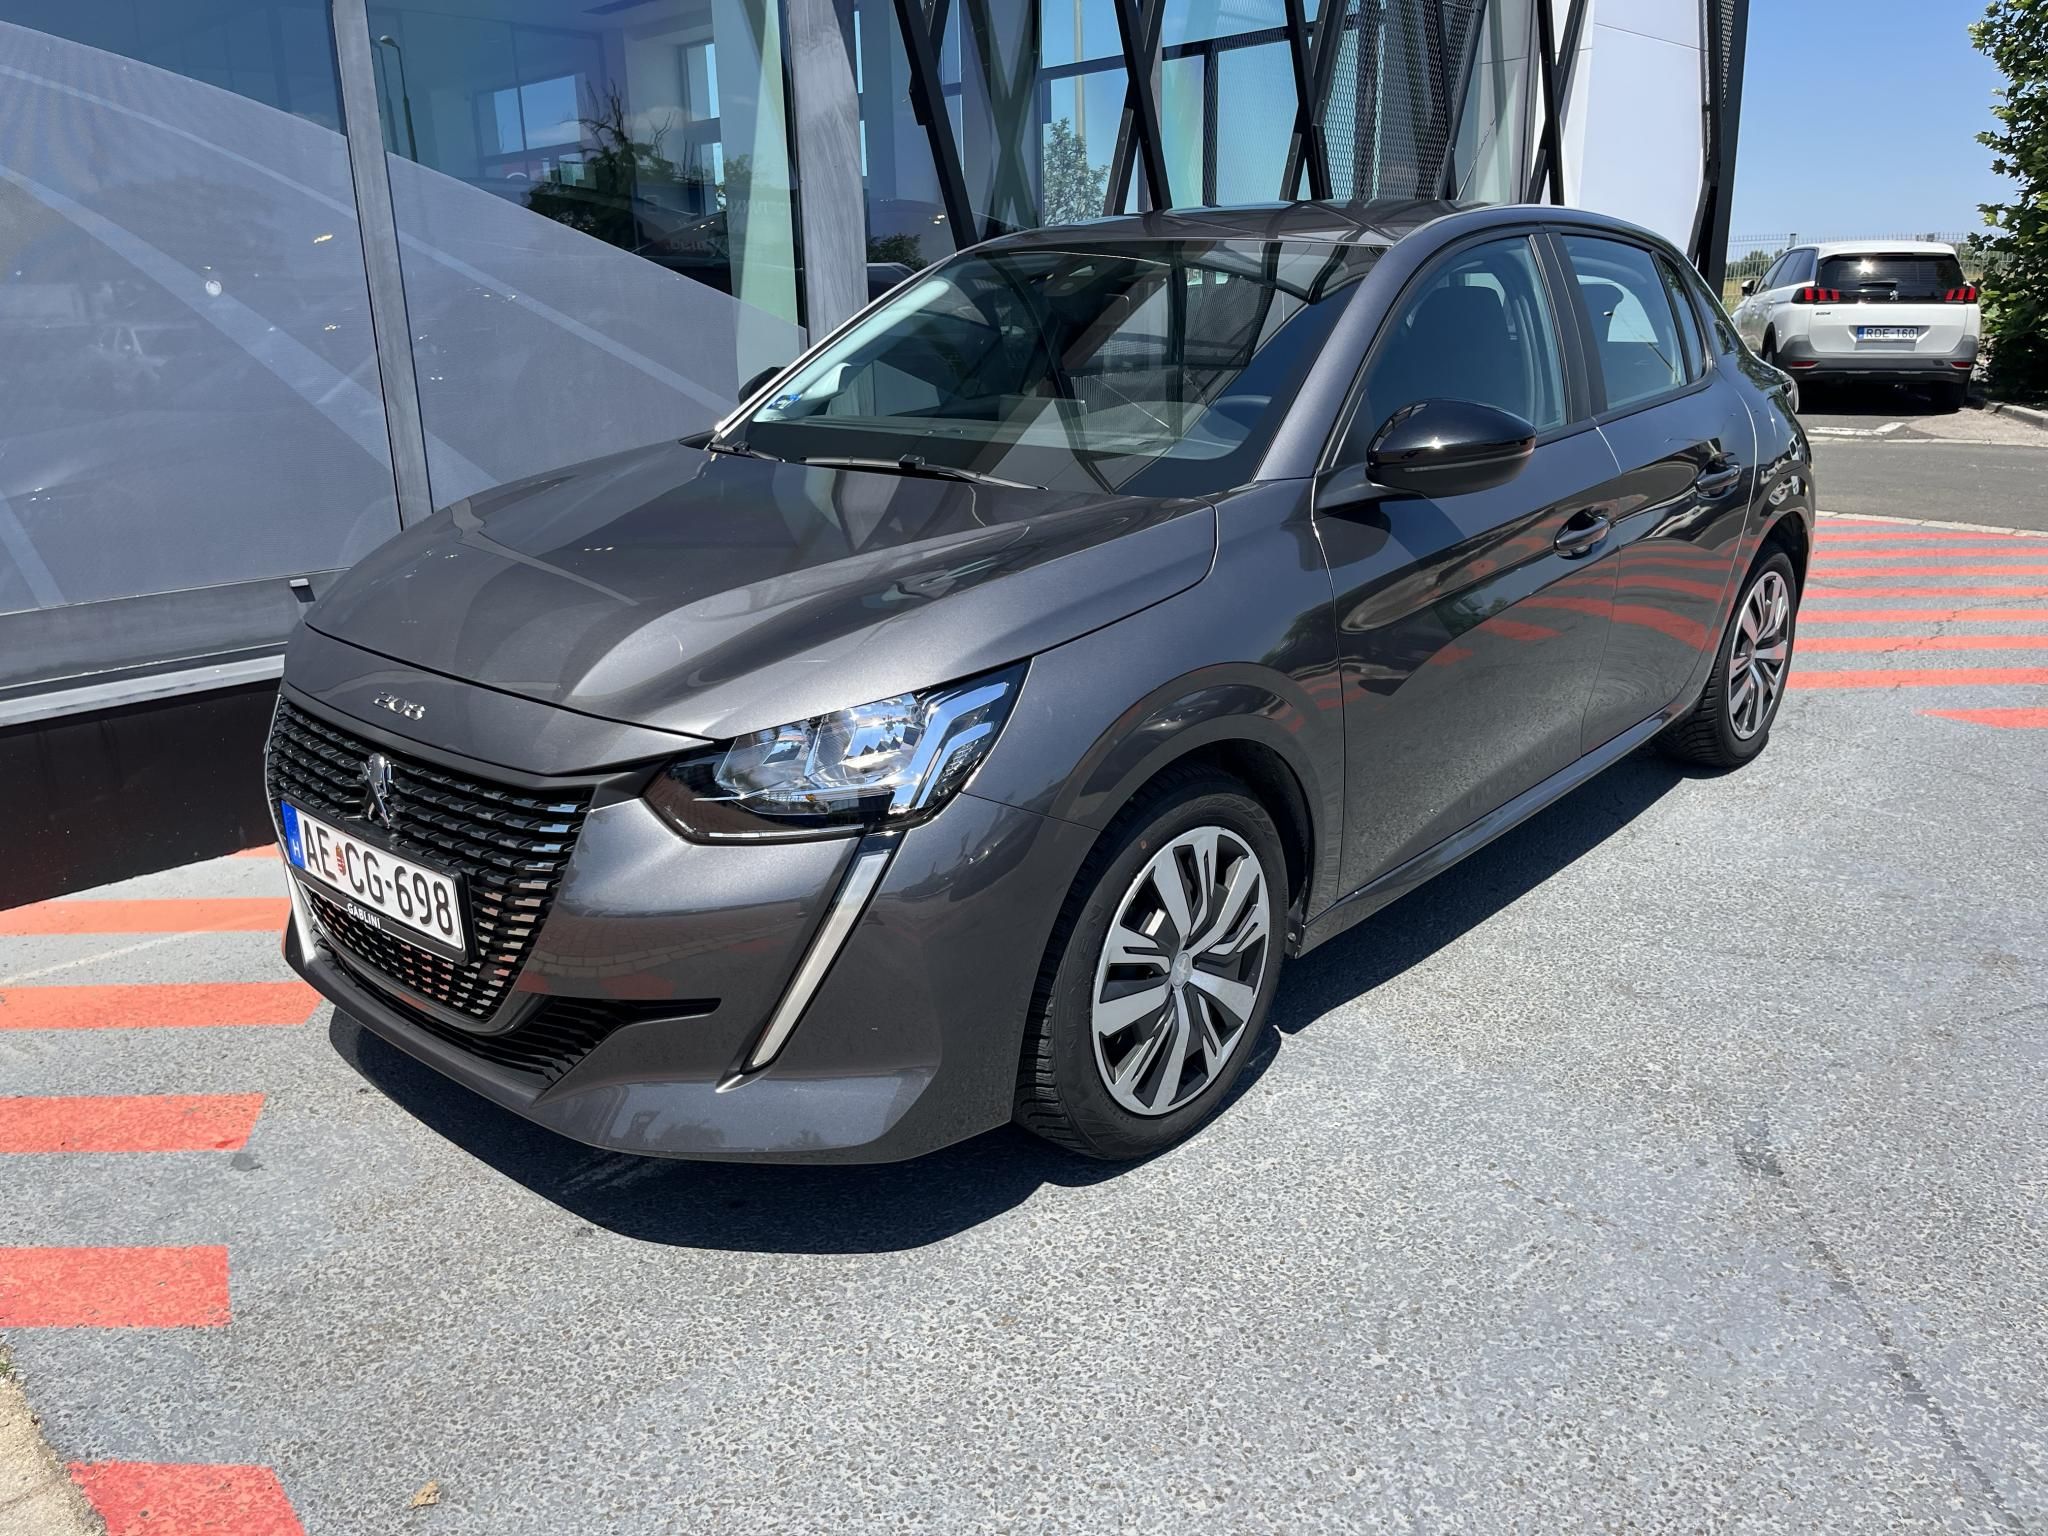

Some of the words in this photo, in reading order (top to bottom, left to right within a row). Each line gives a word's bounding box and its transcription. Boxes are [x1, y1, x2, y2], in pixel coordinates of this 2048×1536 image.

[1866, 328, 1915, 338] RDE-160
[373, 691, 425, 720] 208
[292, 838, 301, 859] H
[303, 819, 338, 882] AE
[345, 841, 453, 936] CG-698
[346, 902, 381, 930] GABLINI
